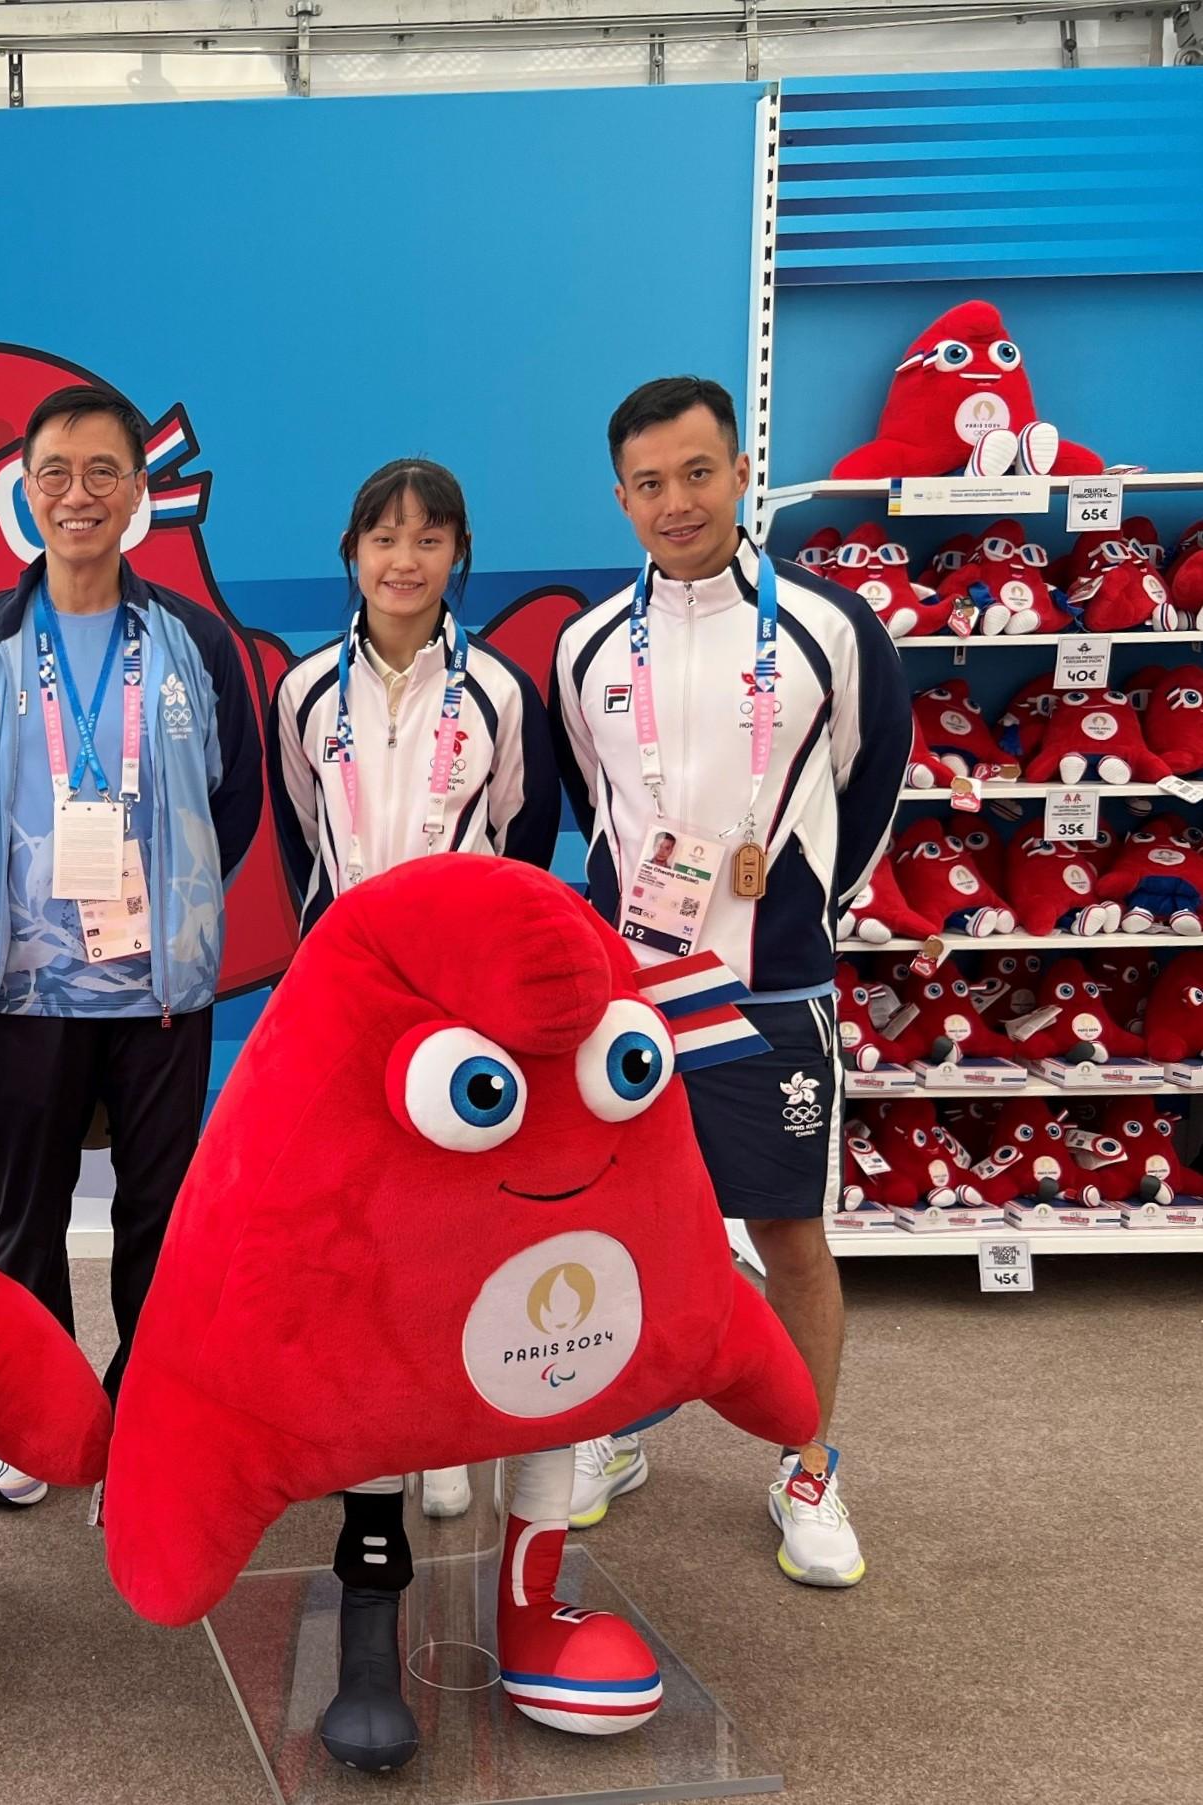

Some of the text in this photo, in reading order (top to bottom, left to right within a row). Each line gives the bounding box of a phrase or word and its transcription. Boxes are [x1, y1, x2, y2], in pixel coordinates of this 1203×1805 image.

[1081, 508, 1108, 520] 65€
[1068, 670, 1097, 682] 40€
[1058, 823, 1084, 835] 35€
[134, 939, 142, 950] 6
[678, 943, 688, 954] R
[806, 1121, 824, 1130] KONG
[796, 1130, 816, 1138] CHINA
[994, 1273, 1020, 1284] 45€
[504, 1331, 613, 1364] PARIS 2024
